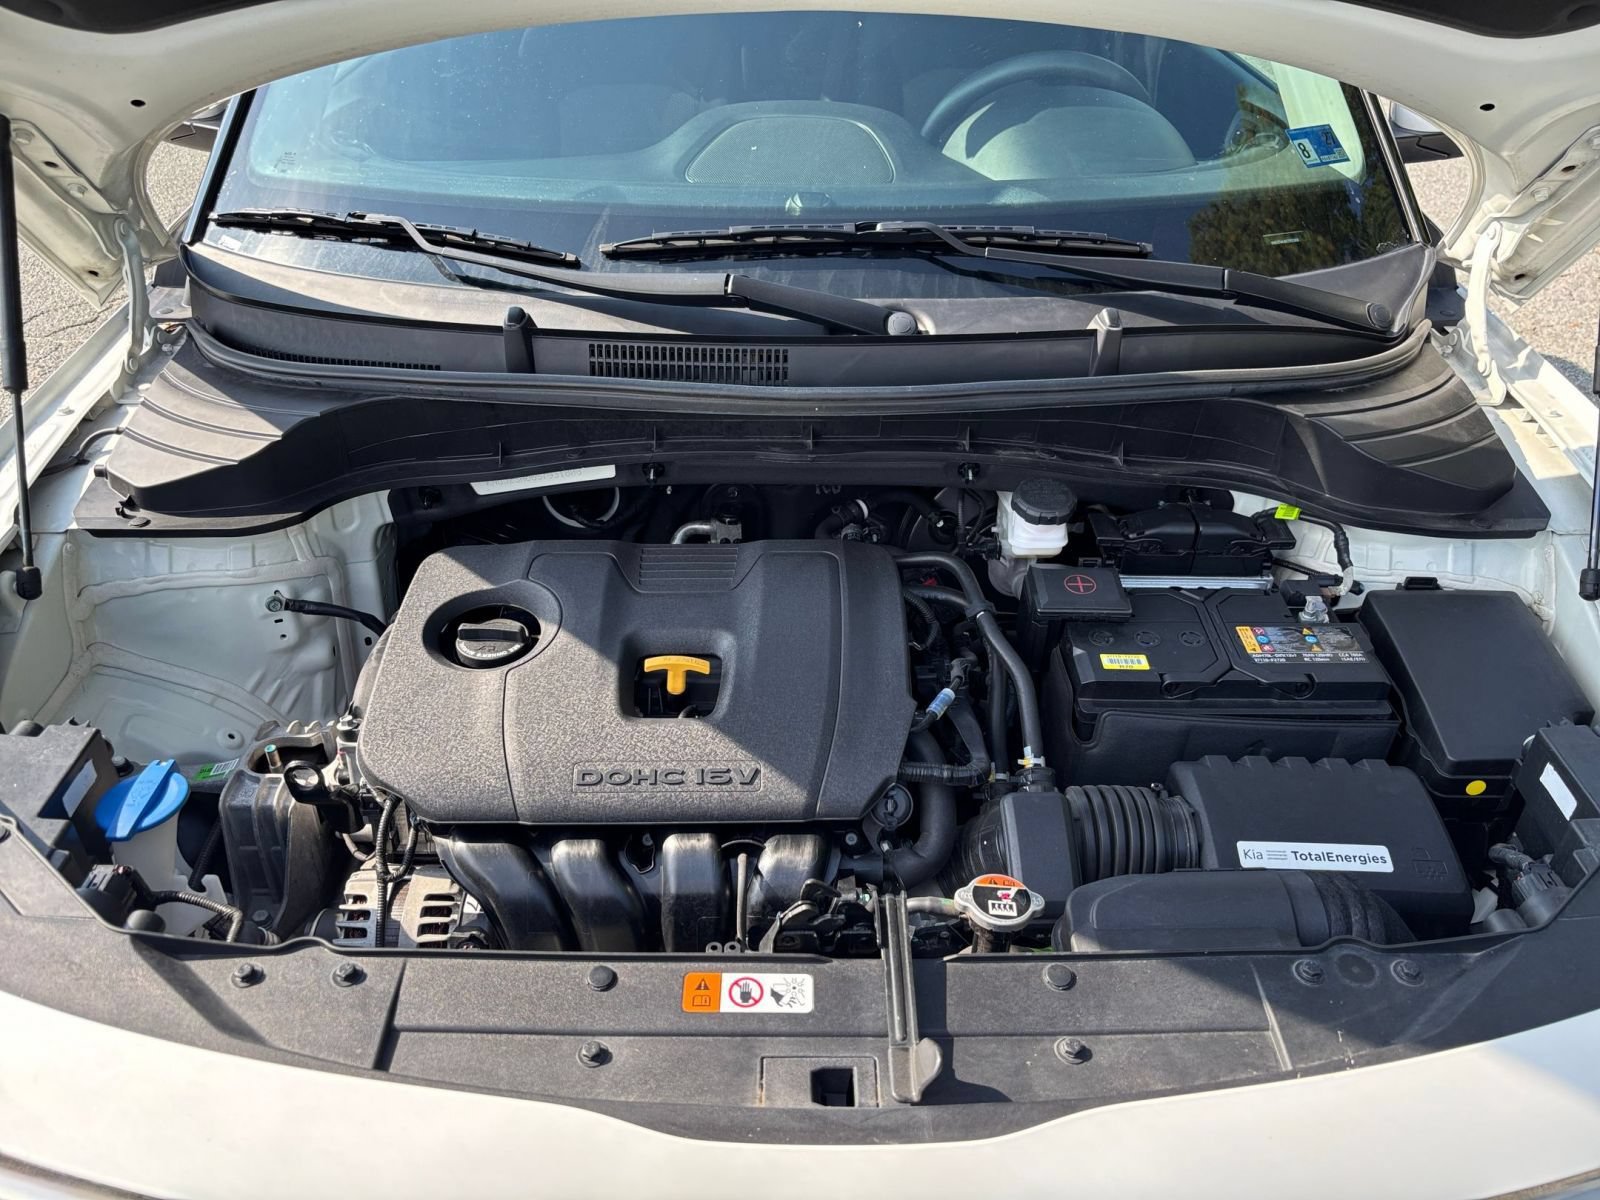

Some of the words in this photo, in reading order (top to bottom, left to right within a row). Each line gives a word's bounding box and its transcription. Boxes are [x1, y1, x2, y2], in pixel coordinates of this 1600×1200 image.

[1297, 142, 1311, 159] 8
[576, 768, 686, 786] DOHC
[695, 767, 761, 786] 16V
[1242, 849, 1264, 860] Kia
[1290, 850, 1388, 865] TotalEnergies
